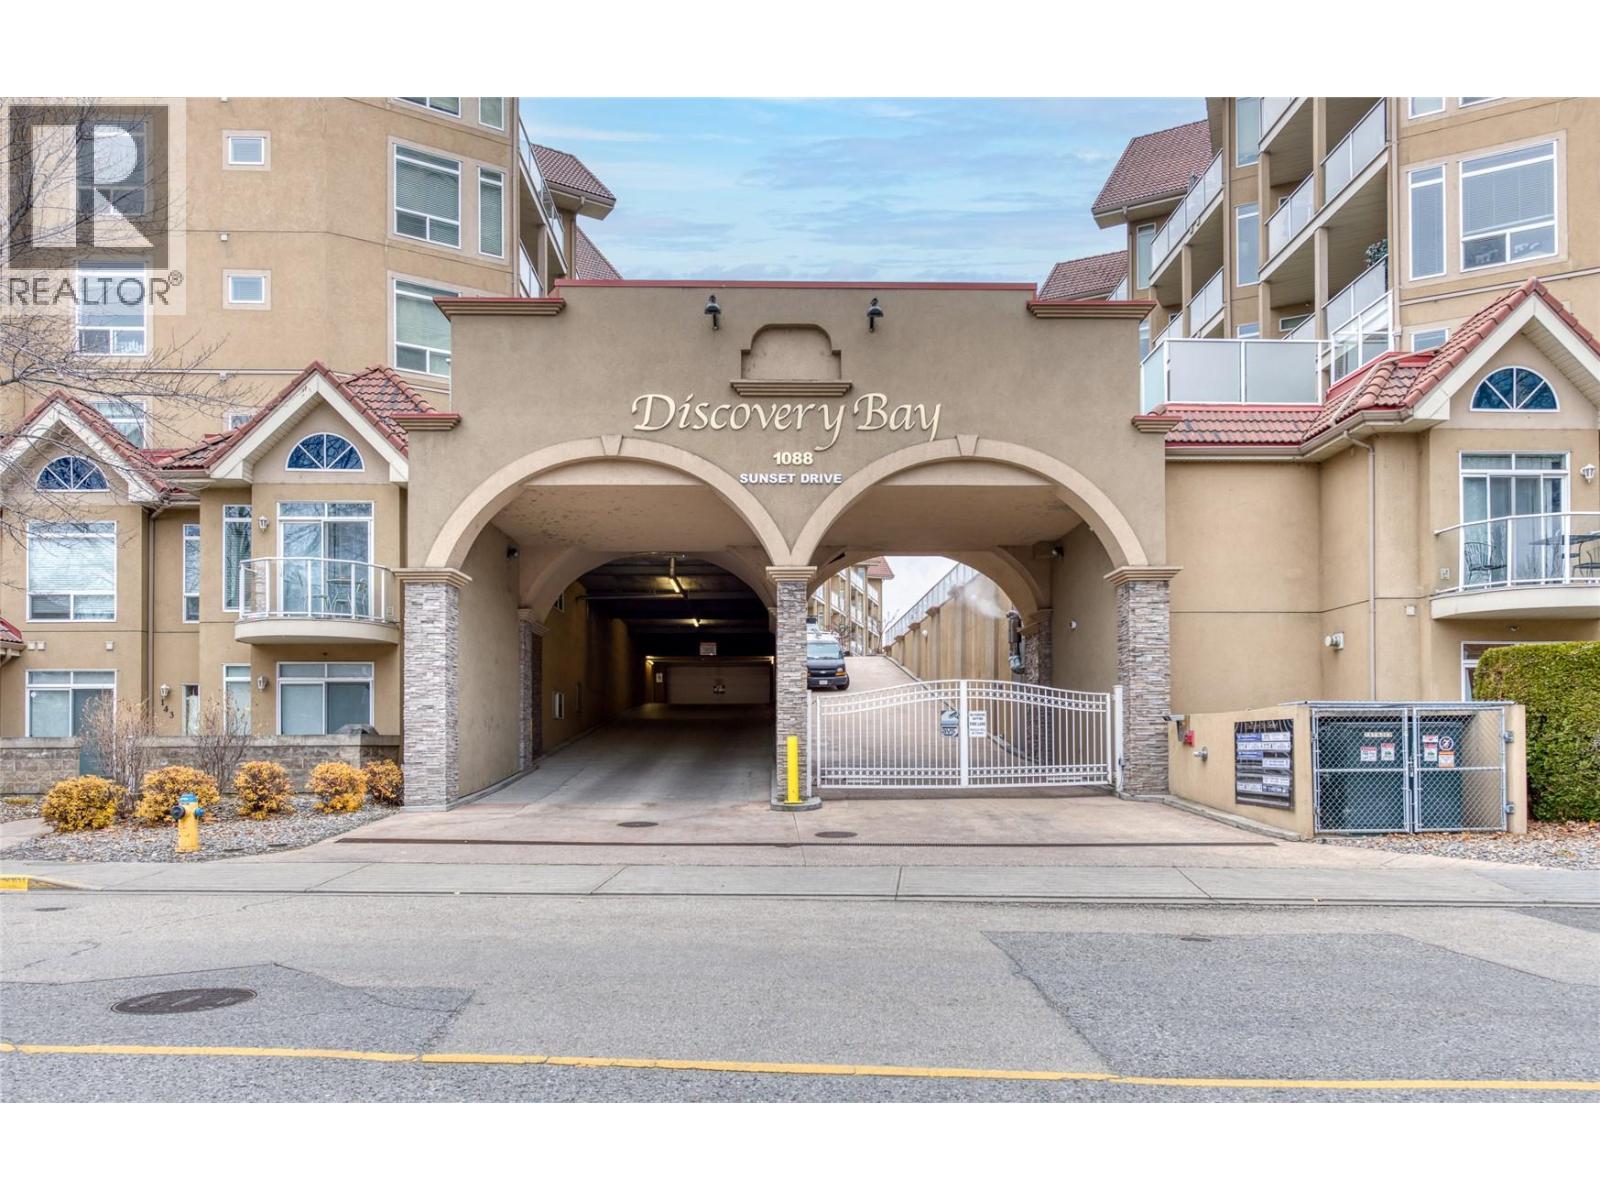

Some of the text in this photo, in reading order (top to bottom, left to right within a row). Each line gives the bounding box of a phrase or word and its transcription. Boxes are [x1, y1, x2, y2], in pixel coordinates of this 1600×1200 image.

[631, 392, 942, 451] Discovery Bay
[773, 451, 814, 465] 1088
[739, 473, 843, 484] SUNSET DRIVE
